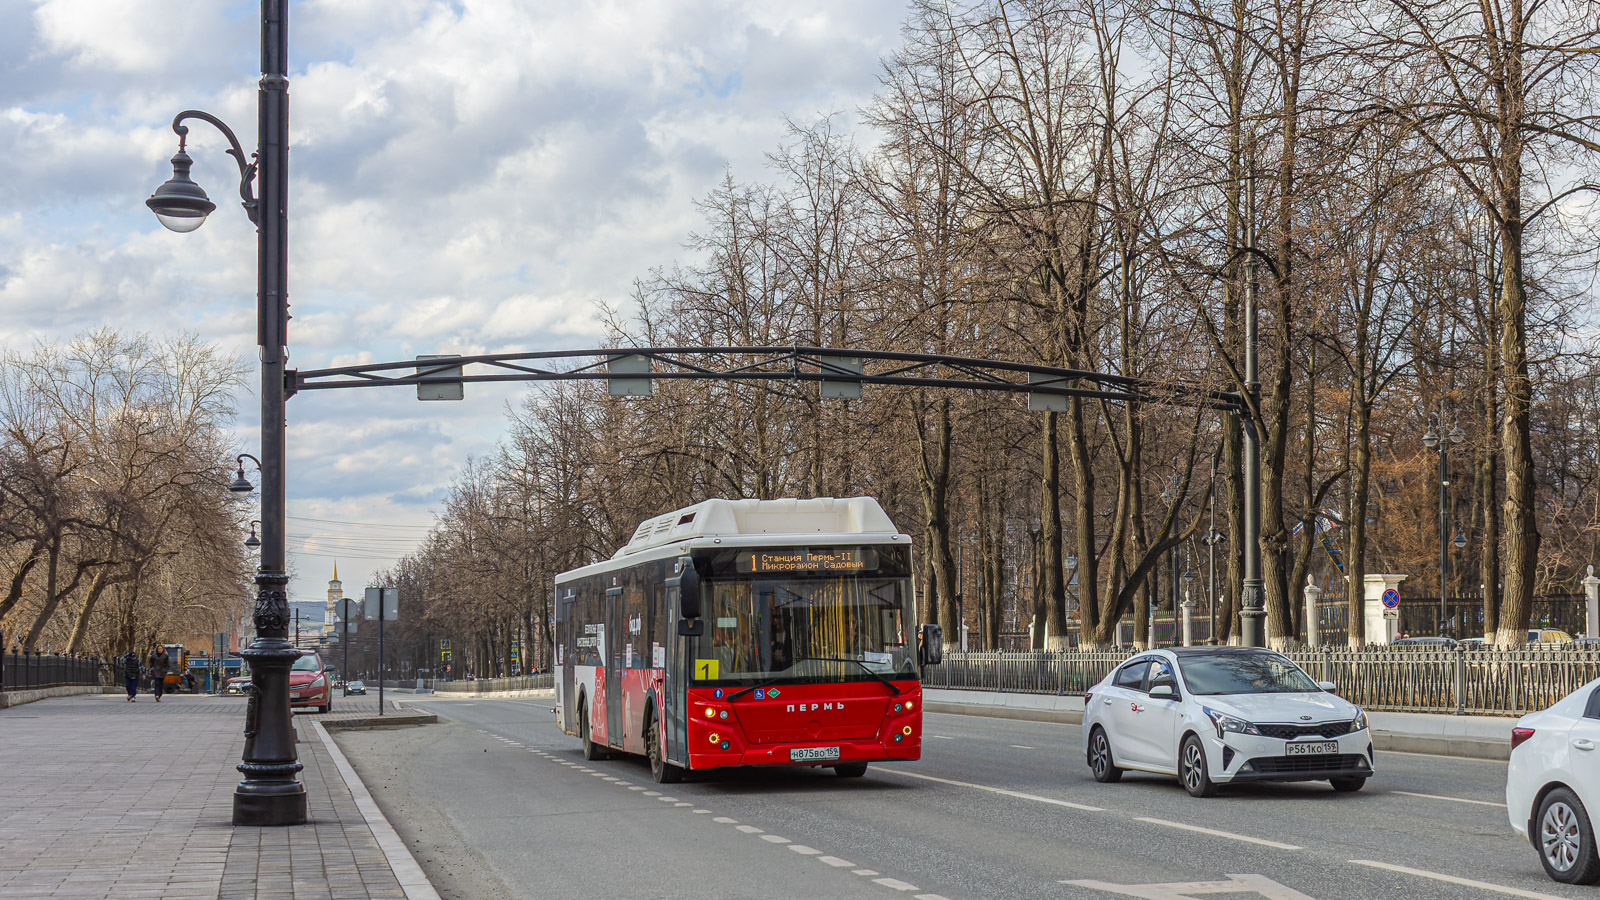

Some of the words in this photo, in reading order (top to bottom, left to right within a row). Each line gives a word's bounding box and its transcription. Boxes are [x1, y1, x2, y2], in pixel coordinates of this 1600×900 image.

[751, 554, 757, 572] 1
[762, 554, 802, 563] Станция
[806, 552, 851, 562] Пермь-II
[762, 561, 819, 570] Микрорайон
[823, 559, 864, 569] Садовый
[701, 663, 709, 680] 1
[787, 702, 844, 712] ПЕРМЬ
[793, 749, 825, 758] Н875ВО
[826, 747, 838, 755] 159
[1289, 744, 1322, 754] Р561КО
[1324, 742, 1335, 751] 159
